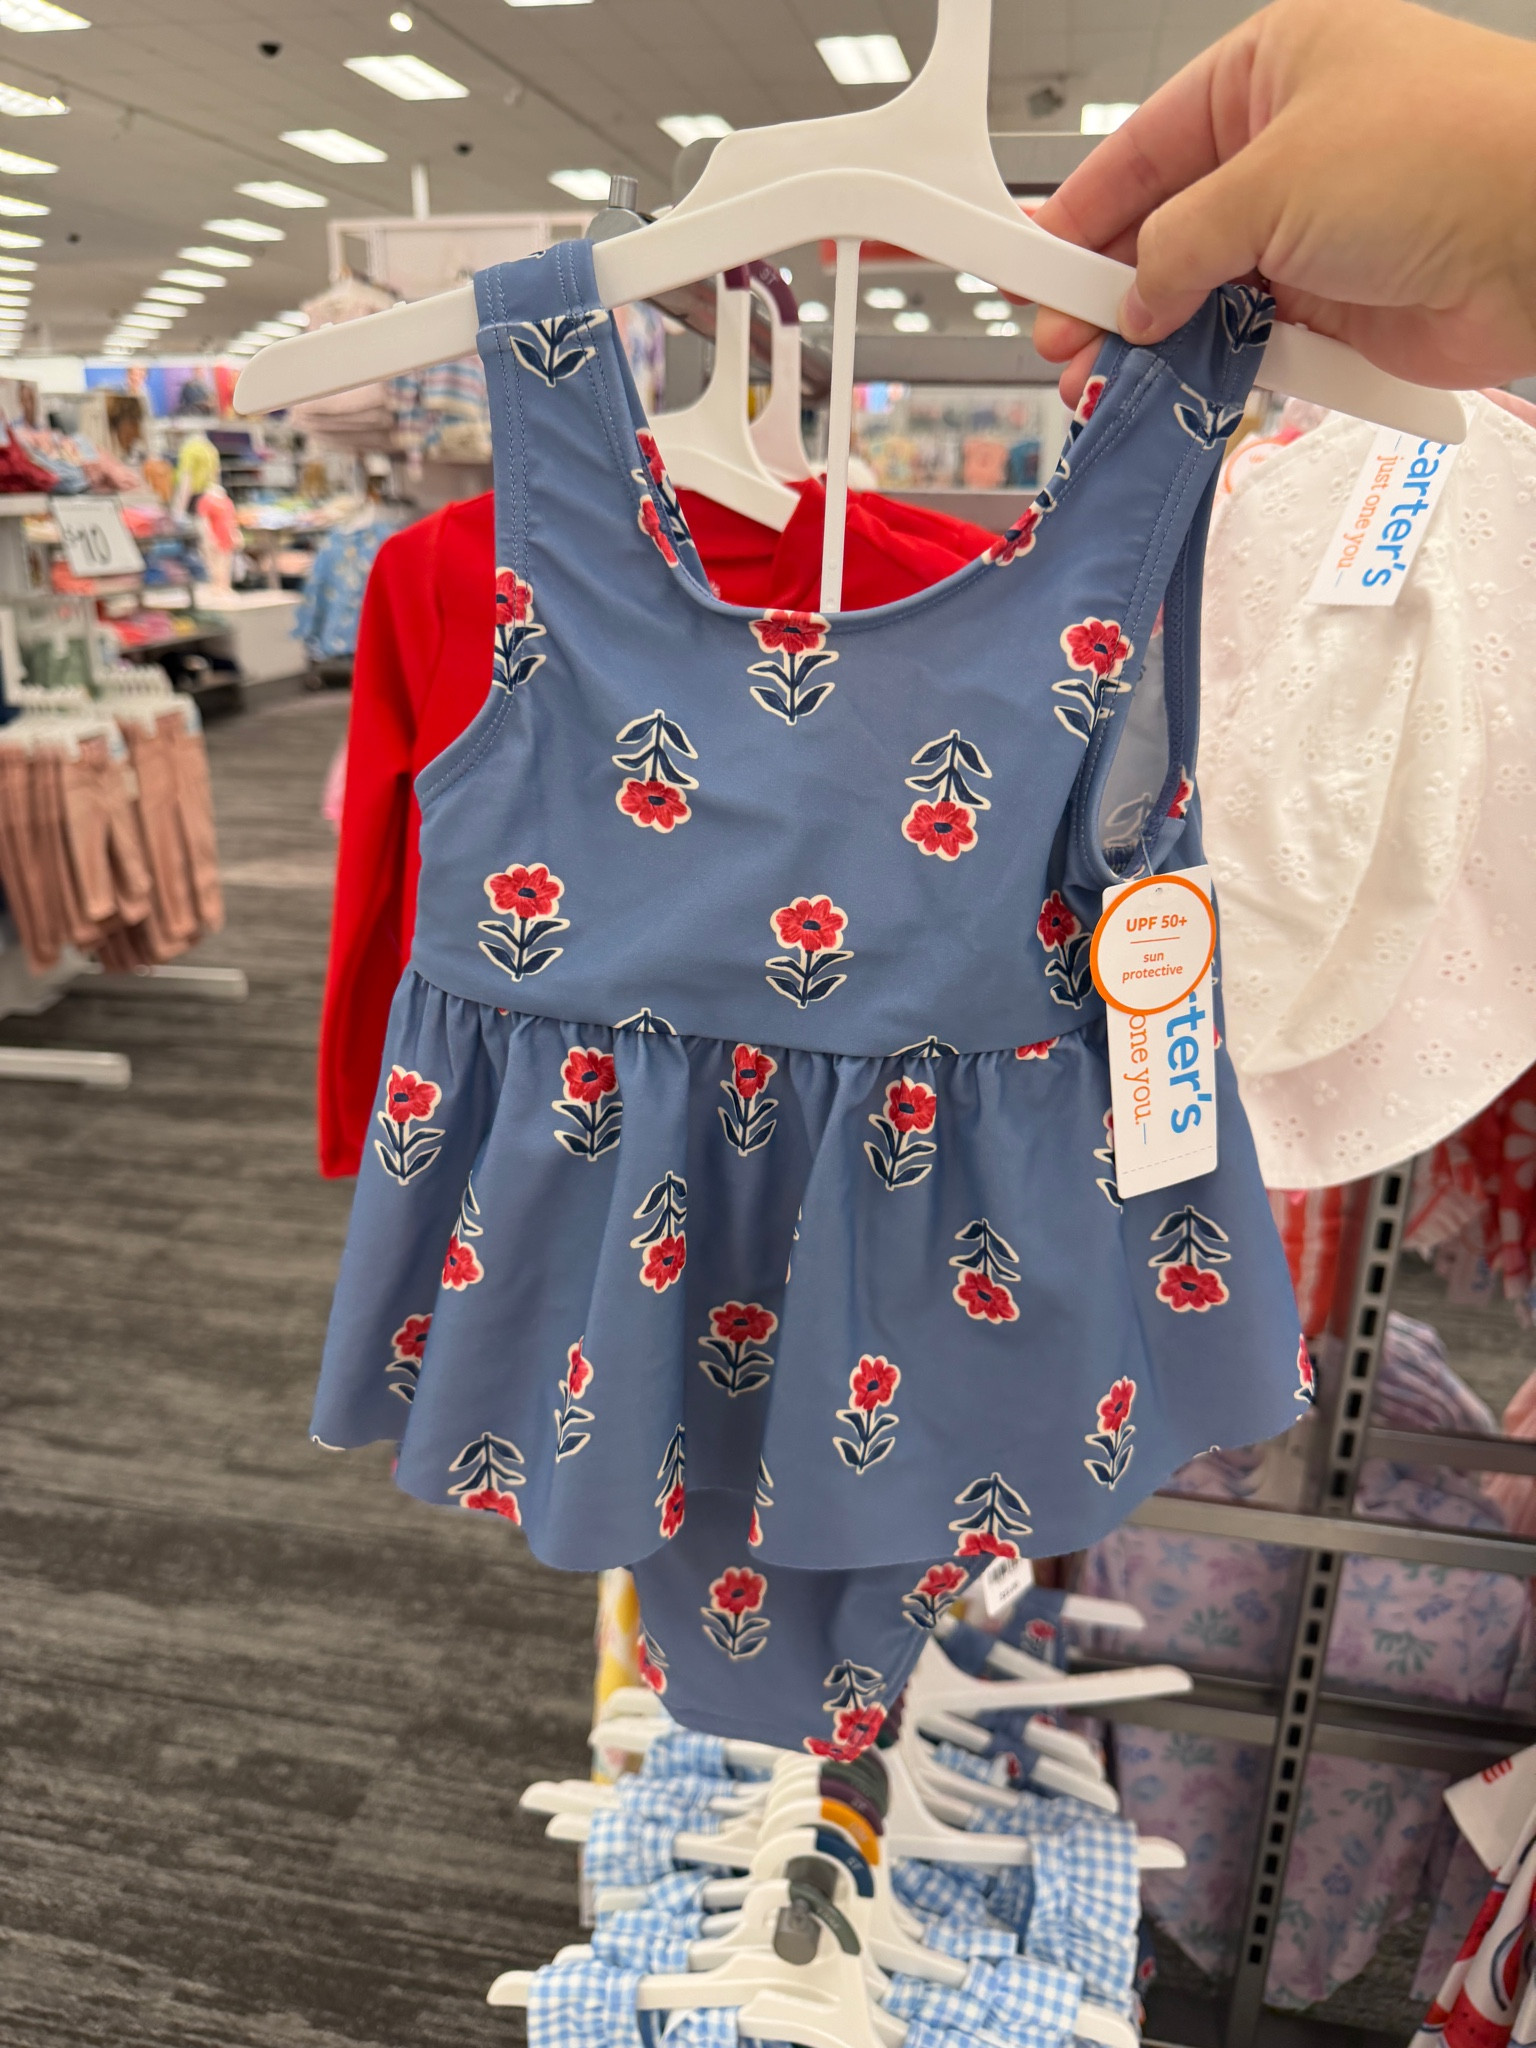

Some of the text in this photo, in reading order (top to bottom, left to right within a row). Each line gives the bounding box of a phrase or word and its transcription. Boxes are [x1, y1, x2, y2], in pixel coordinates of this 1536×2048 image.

[1371, 455, 1404, 490] just
[1354, 495, 1380, 530] one
[1126, 914, 1187, 932] UPF 50+
[1122, 964, 1183, 984] protective
[1143, 952, 1164, 963] sun
[1123, 1014, 1151, 1125] one you.
[1166, 990, 1212, 1133] ter's
